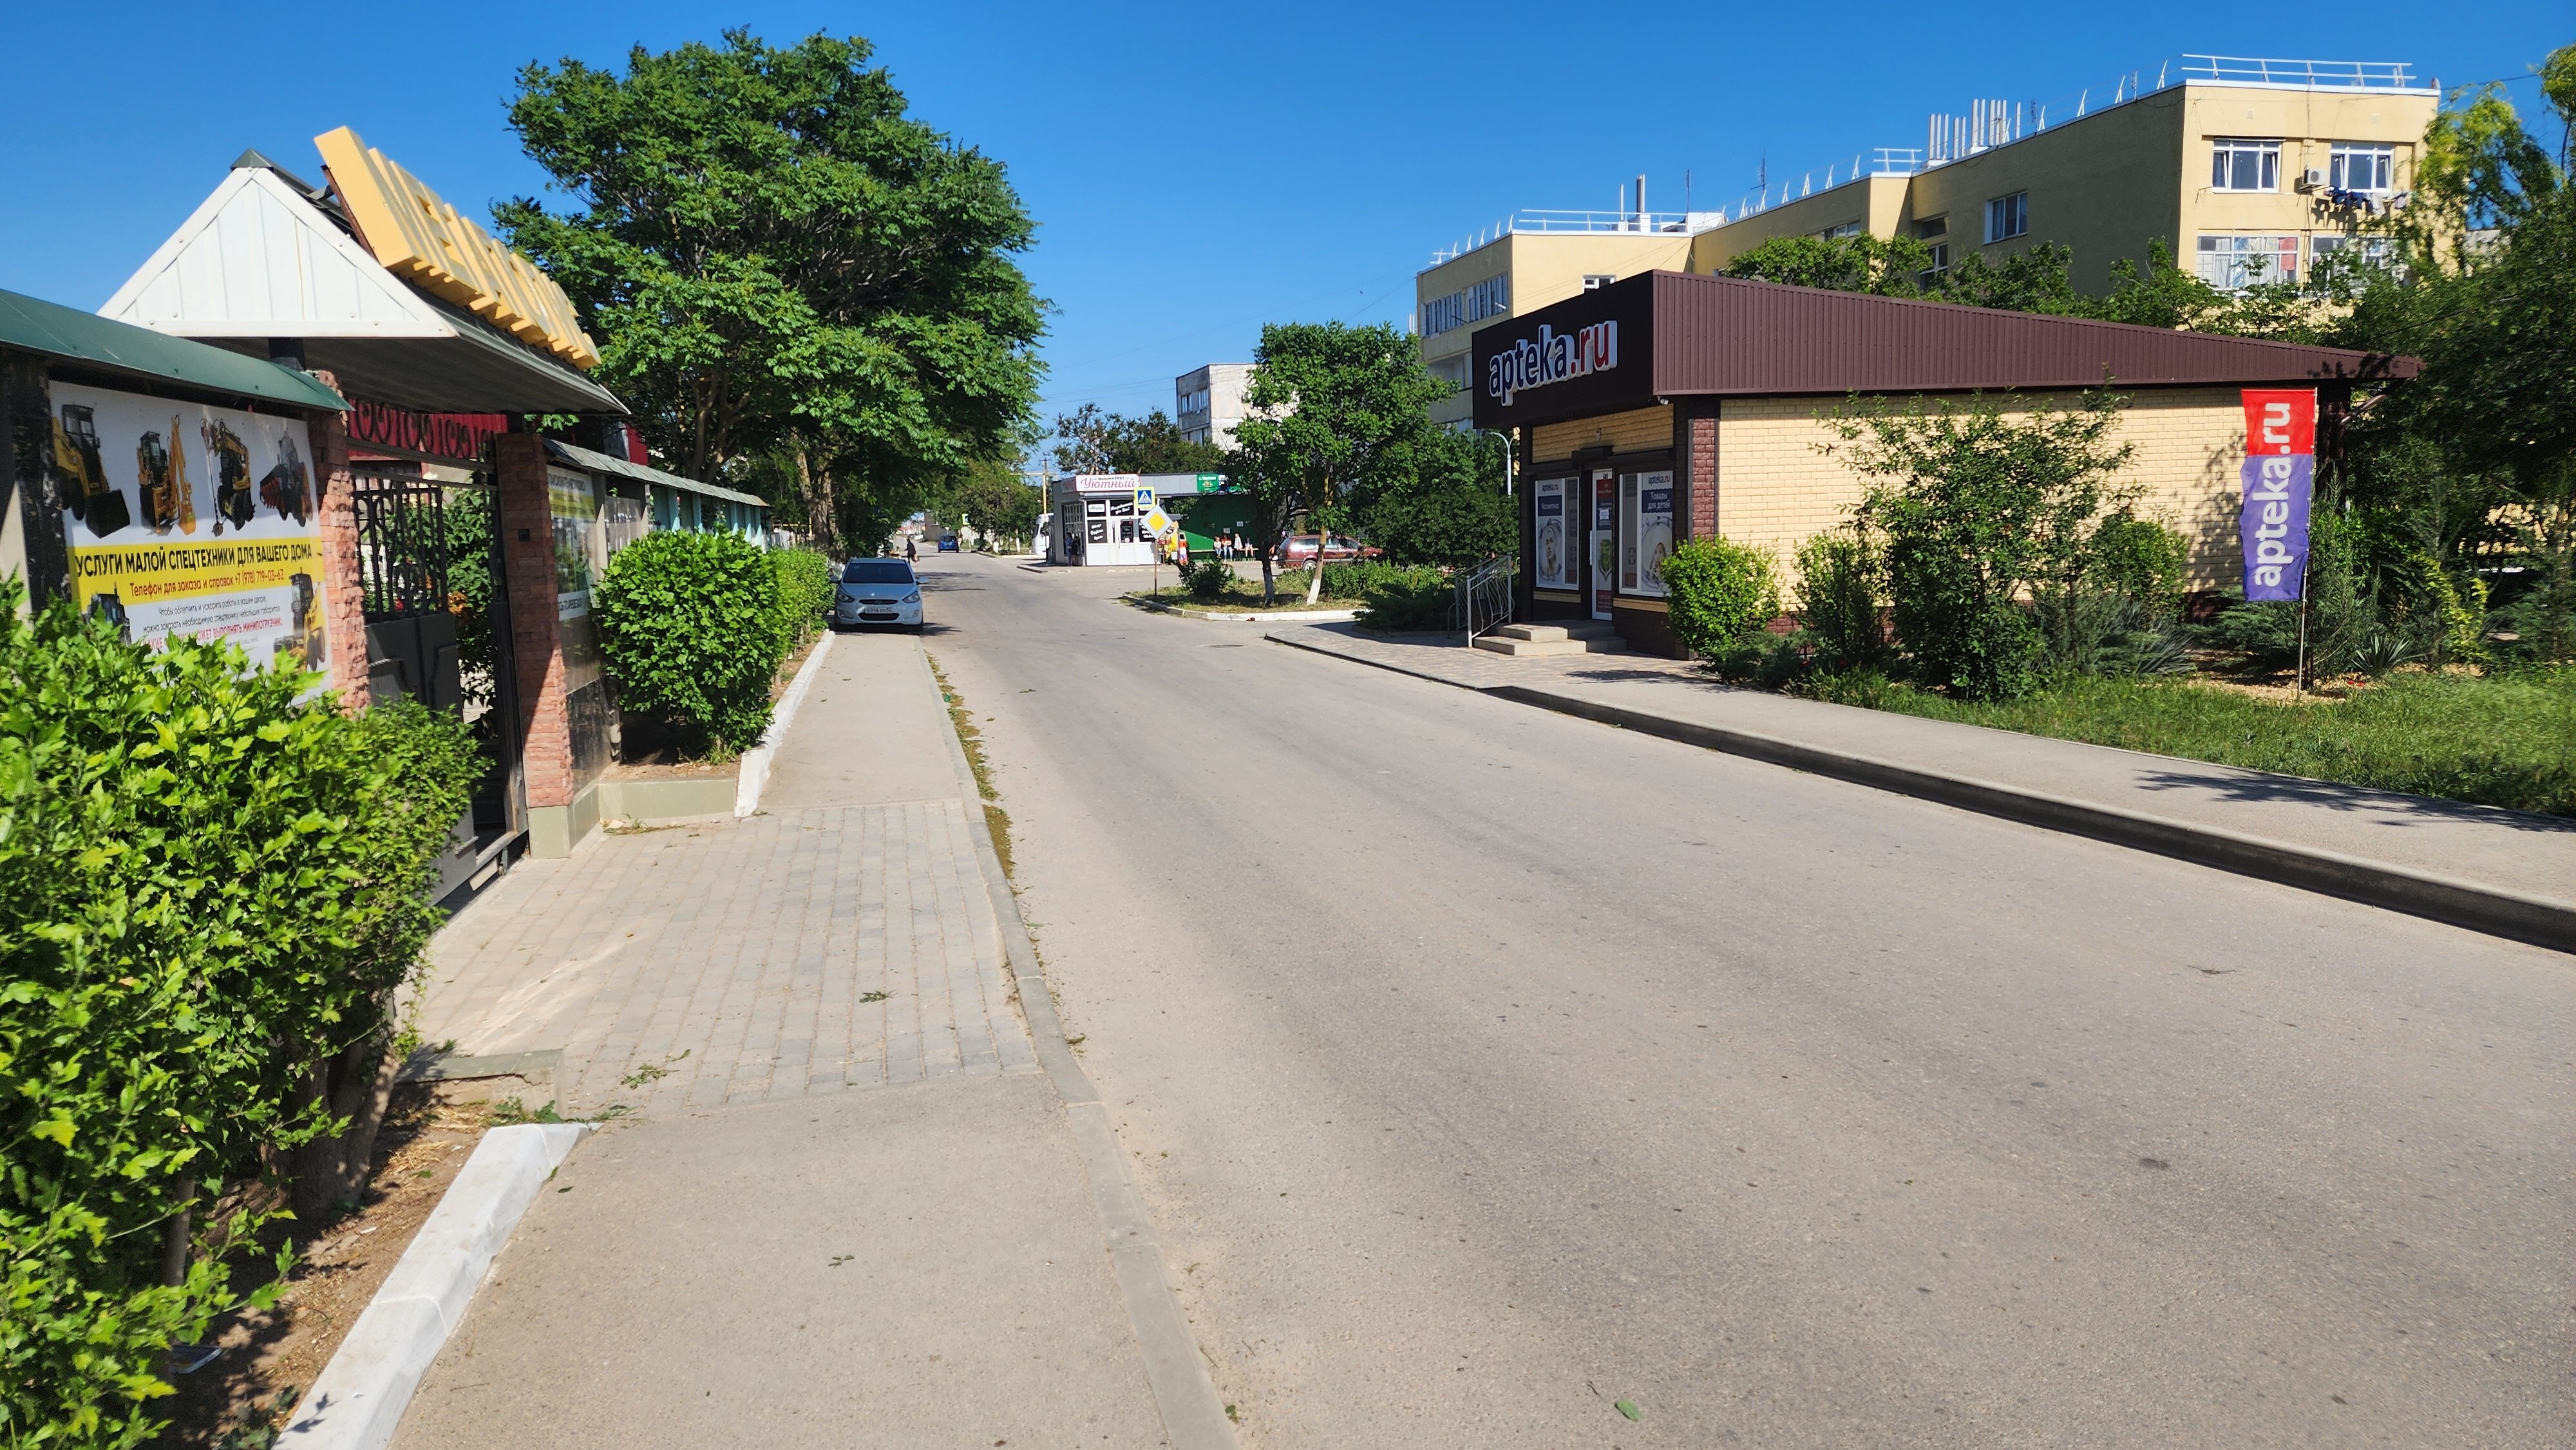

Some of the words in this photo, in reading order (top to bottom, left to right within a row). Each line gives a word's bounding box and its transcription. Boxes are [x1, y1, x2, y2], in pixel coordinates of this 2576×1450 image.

[1490, 321, 1617, 406] apteka.ru
[1081, 478, 1135, 489] Уютный
[1648, 475, 1670, 487] apteka.ru
[1542, 483, 1559, 493] apteka.ru
[1651, 492, 1667, 501] Товары
[2253, 402, 2293, 587] apteka.ru
[1648, 502, 1656, 511] для
[1657, 500, 1670, 511] детей
[75, 553, 123, 577] УСЛУГИ
[126, 546, 166, 573] МАЛОЙ
[169, 547, 234, 571] СПЕЦТЕХНИКИ
[237, 547, 255, 567] ДЛЯ
[257, 545, 289, 563] ВАШЕГО
[291, 543, 312, 562] ДОМА
[130, 581, 162, 599] Телефон
[164, 583, 176, 596] для
[178, 580, 201, 591] заказа
[204, 580, 207, 588] и
[209, 577, 233, 590] справок
[234, 573, 241, 585] +7
[242, 570, 255, 586] (978)
[256, 569, 283, 583] 719-03-63
[158, 607, 174, 616] Чтобы
[175, 605, 197, 614] облегчить
[160, 622, 182, 630] заказать
[182, 615, 213, 627] необходимую
[196, 628, 213, 641] ОЖЕТ
